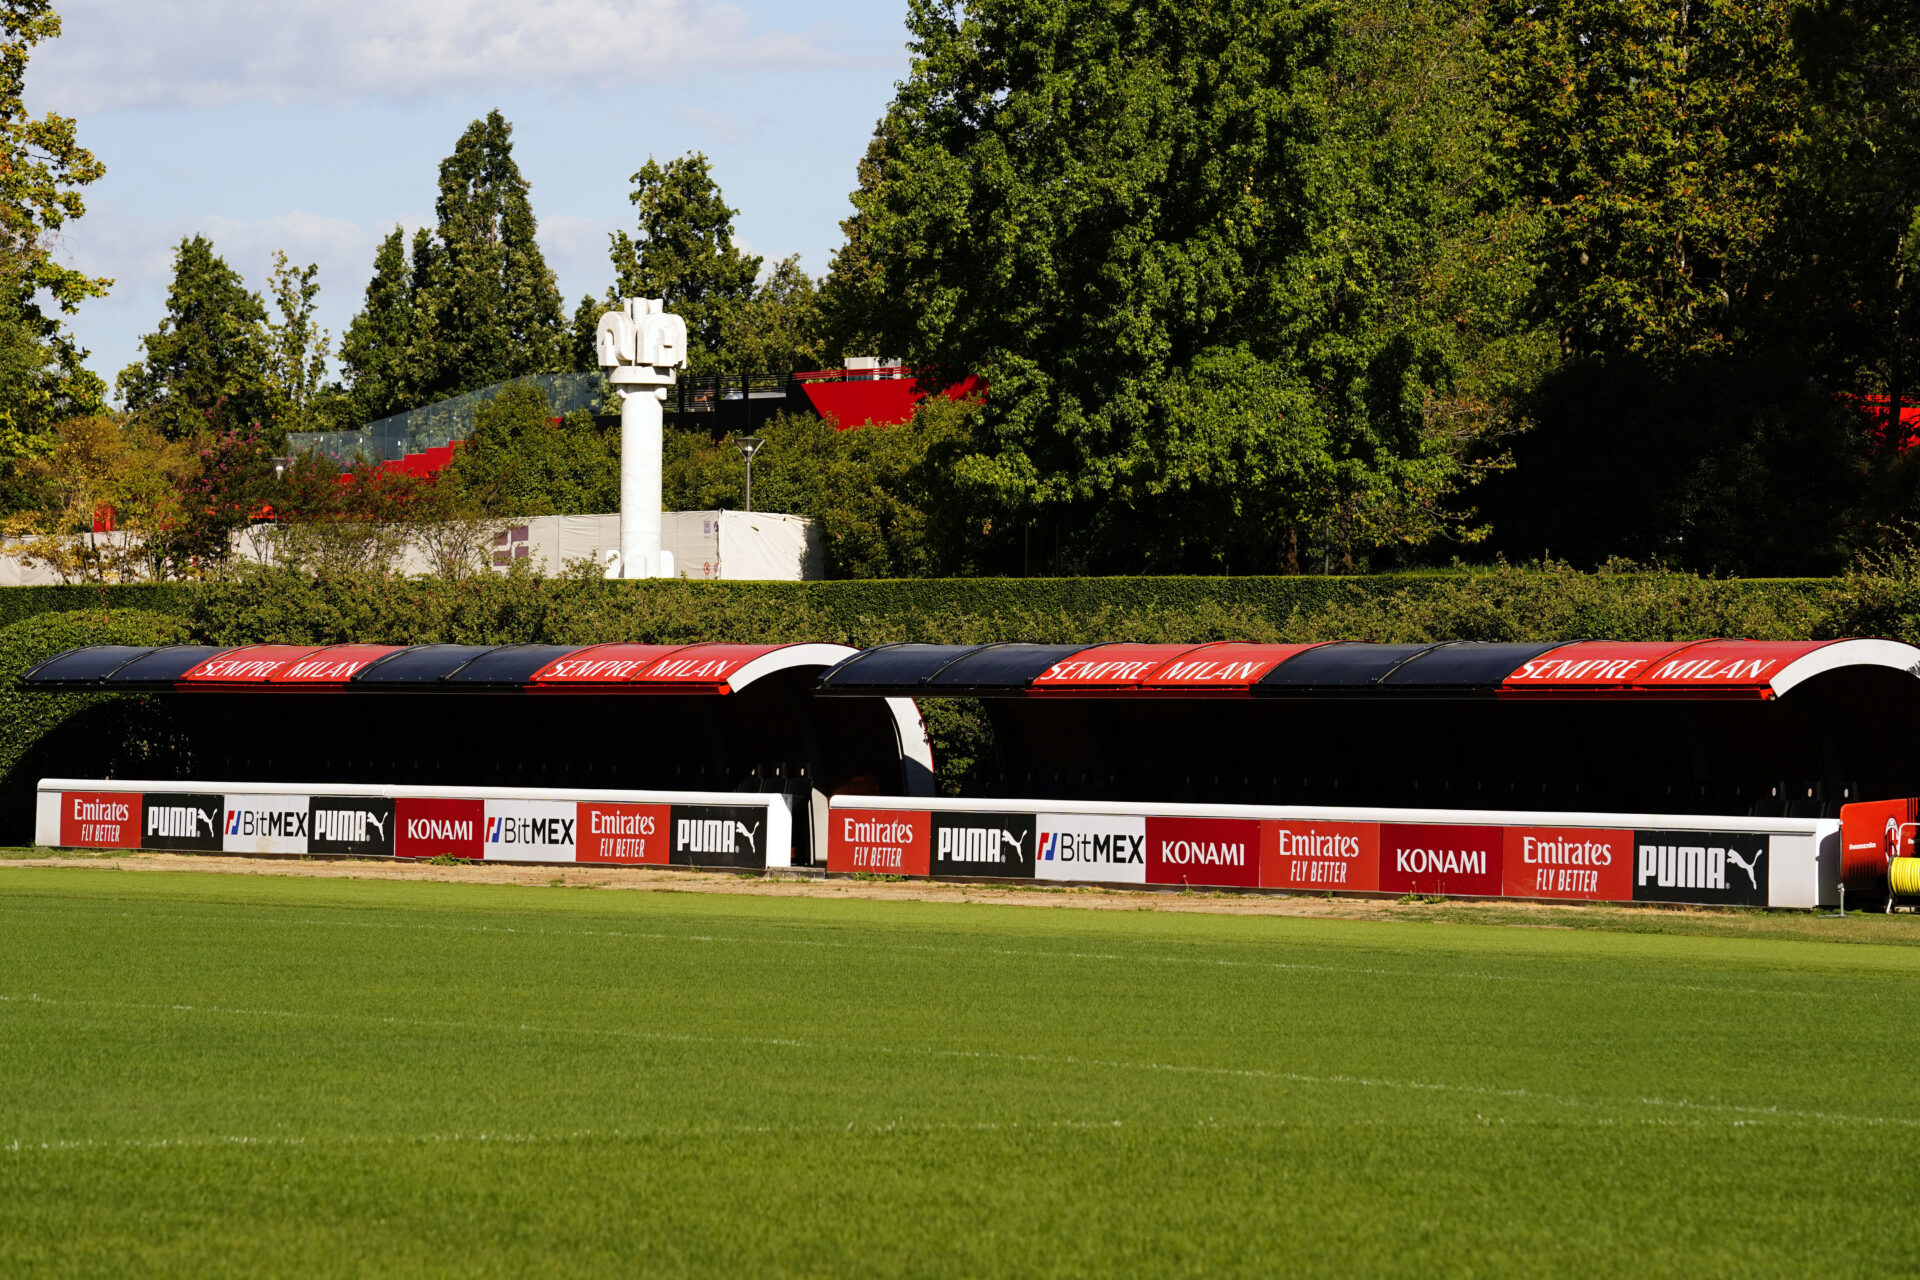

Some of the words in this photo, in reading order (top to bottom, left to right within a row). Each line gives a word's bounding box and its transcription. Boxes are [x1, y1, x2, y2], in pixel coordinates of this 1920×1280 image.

[195, 660, 287, 677] SEMPRE
[283, 661, 368, 678] MILAN
[545, 660, 646, 677] SEMPRE
[645, 660, 739, 677] MILAN
[1040, 661, 1158, 680] SEMPRE
[1158, 661, 1266, 680] MILAN
[1511, 659, 1648, 680] SEMPRE
[1651, 659, 1777, 680] MILAN
[74, 798, 129, 822] Emirates
[147, 806, 197, 838] PUMA
[591, 810, 655, 836] Emirates
[81, 824, 94, 842] FLY
[95, 825, 121, 843] BETTER
[243, 811, 308, 837] BitMEX
[314, 810, 367, 842] PUMA
[407, 818, 473, 840] KONAMI
[504, 817, 575, 845] BitMEX
[677, 819, 735, 853] PUMA
[844, 817, 913, 844] Emirates
[600, 837, 614, 857] FLY
[615, 838, 645, 858] BETTER
[938, 827, 1000, 863] PUMA
[1060, 833, 1145, 864] BitMEX
[1161, 841, 1245, 866] KONAMI
[1278, 829, 1360, 857] Emirates
[1523, 836, 1612, 866] Emirates
[853, 846, 869, 866] FLY
[871, 846, 902, 867] BETTER
[1396, 848, 1486, 875] KONAMI
[1638, 845, 1726, 889] PUMA
[1290, 860, 1309, 882] FLY
[1310, 861, 1347, 884] BETTER
[1536, 868, 1556, 891] FLY
[1557, 869, 1598, 893] BETTER
